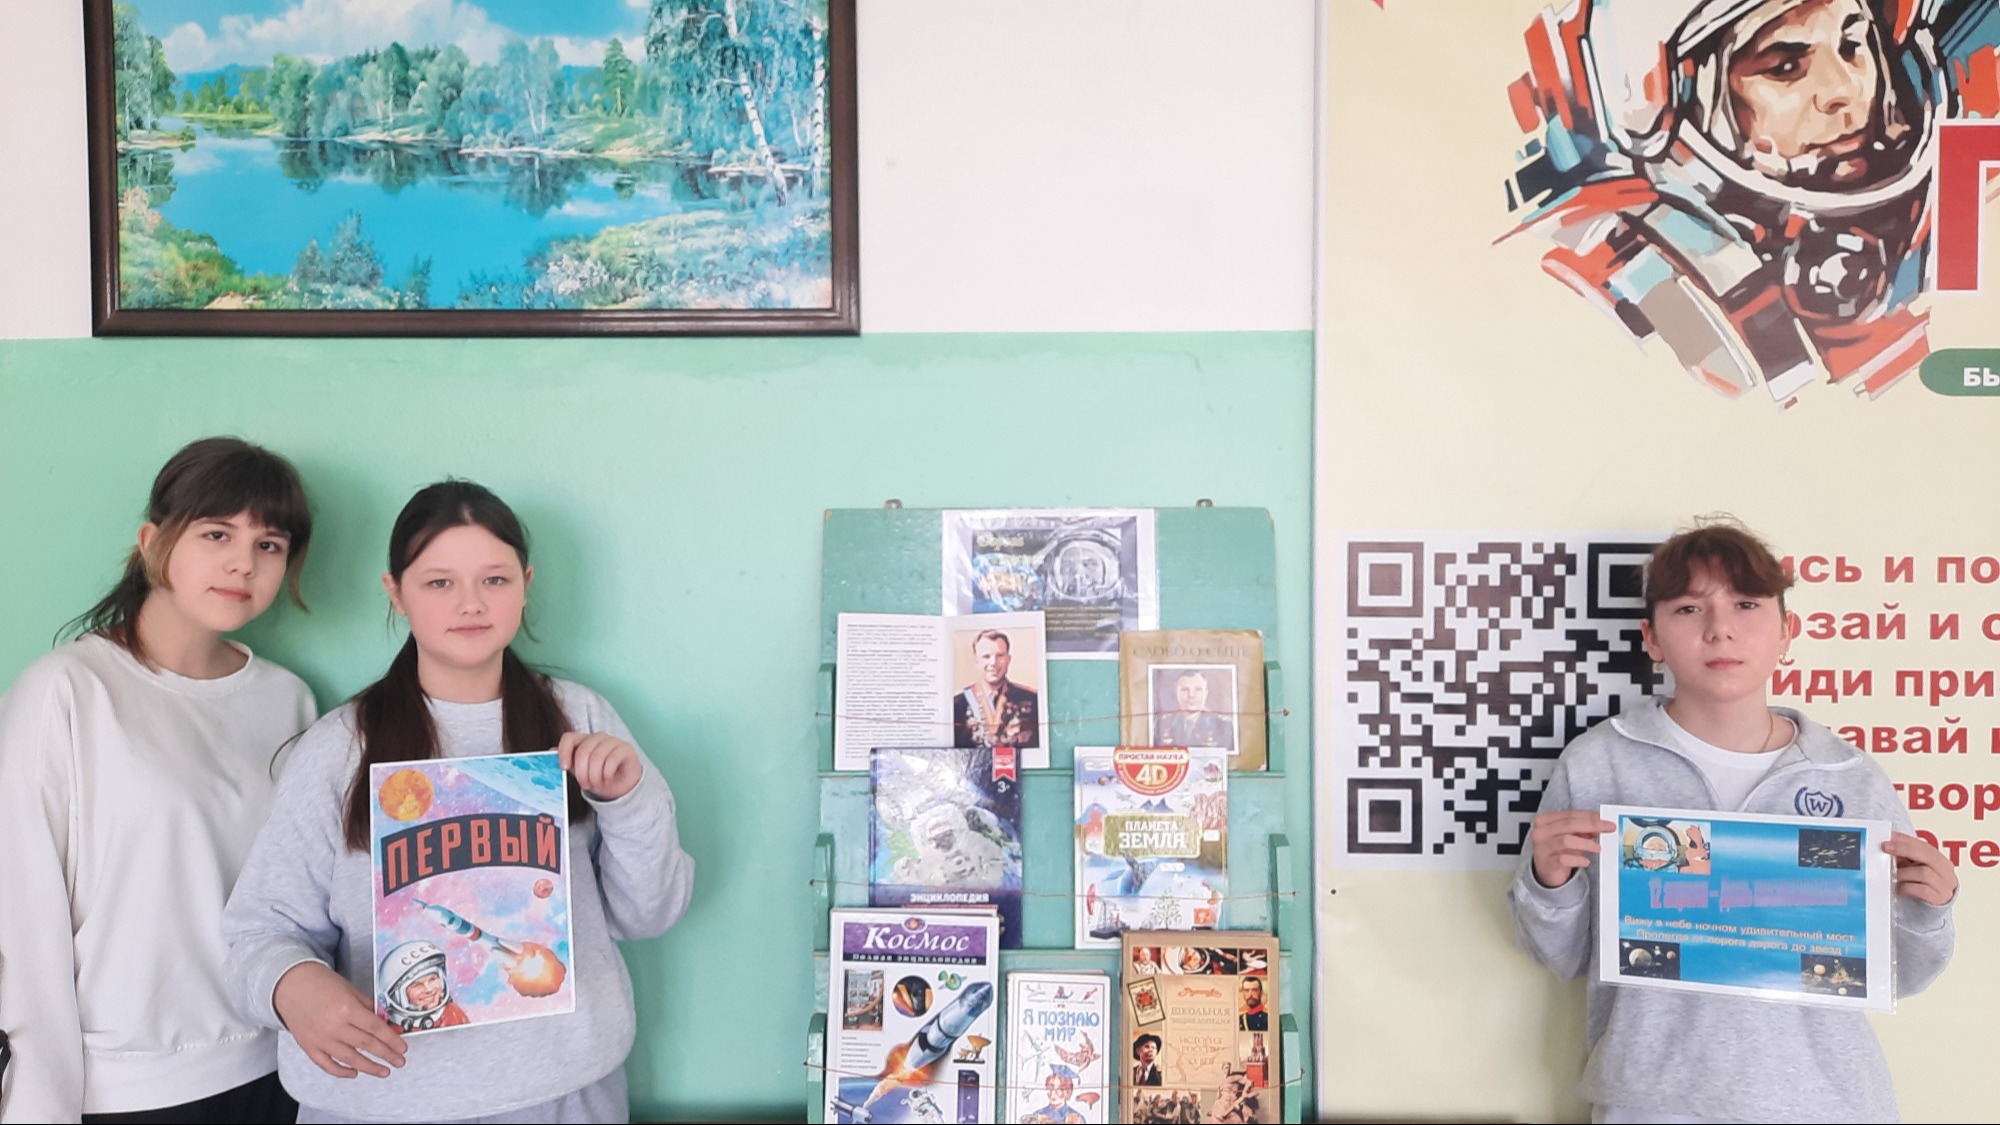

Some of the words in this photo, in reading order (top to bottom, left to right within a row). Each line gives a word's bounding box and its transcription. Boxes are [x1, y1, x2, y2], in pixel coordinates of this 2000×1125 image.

[1884, 556, 1914, 583] и
[1929, 613, 1959, 640] и
[1826, 716, 1968, 754] авай
[1118, 753, 1155, 761] ПРОСТАЯ
[1156, 753, 1185, 761] НАУКА
[1135, 764, 1168, 786] 4D
[1809, 798, 1829, 813] W
[1125, 820, 1179, 832] ПЛАНЕТА
[1118, 832, 1188, 849] ЗЕМЛЯ
[386, 816, 558, 890] ПЕРВЫЙ
[910, 892, 989, 904] ЭНЦИКЛОПЕДИЯ
[1624, 914, 1654, 928] Вижу
[1666, 919, 1693, 930] небе
[1695, 923, 1738, 933] ночном
[1740, 926, 1823, 940] удивительный
[1826, 933, 1855, 943] мост
[1748, 939, 1788, 950] дорога
[1791, 943, 1806, 953] до
[1022, 1008, 1035, 1026] Я
[1038, 1010, 1101, 1028] ПОЗНАЮ
[1170, 1007, 1231, 1017] ШКОЛЬНАЯ
[1044, 1026, 1077, 1042] МИР
